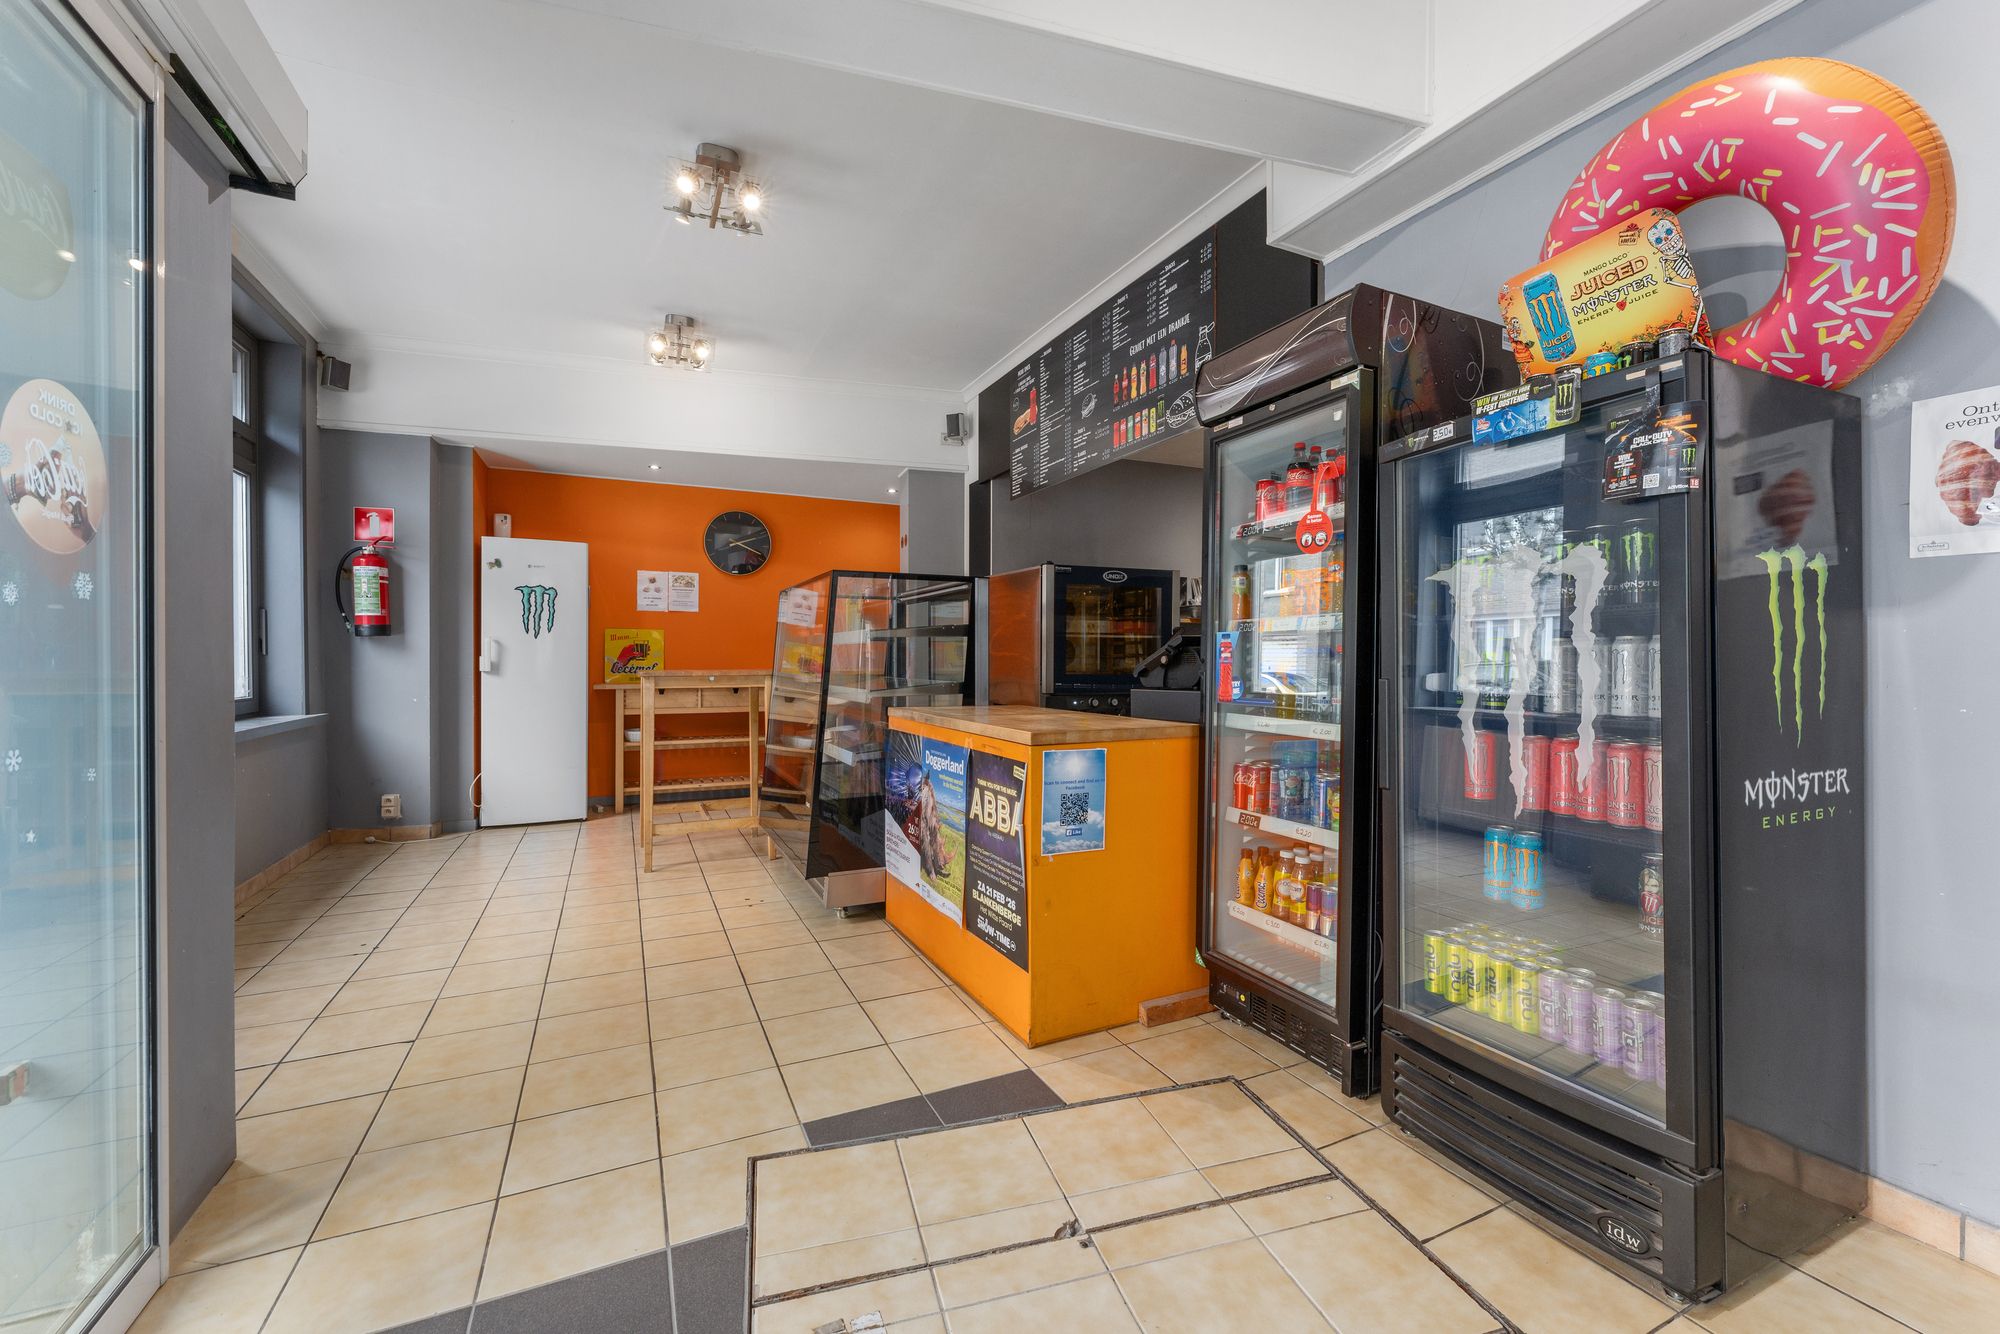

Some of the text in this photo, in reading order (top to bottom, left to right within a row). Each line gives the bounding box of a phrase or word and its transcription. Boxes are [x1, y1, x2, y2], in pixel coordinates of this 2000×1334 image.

[1583, 253, 1628, 276] MANGO LOCO
[1571, 255, 1648, 301] JUICED
[1572, 274, 1658, 317] MONSTER
[1577, 288, 1658, 325] ENERGY JUICE
[1146, 334, 1157, 346] MET
[1476, 397, 1491, 407] WIN
[1633, 435, 1648, 444] CALL
[1652, 430, 1672, 440] DUTY
[925, 750, 964, 775] Doggerland
[1744, 768, 1850, 810] MONSTER
[1762, 806, 1836, 829] ENERGY
[977, 880, 986, 894] ZA
[985, 885, 993, 897] 21
[993, 889, 1005, 905] FEB
[972, 888, 1022, 927] BLANKENBERGE
[998, 915, 1013, 932] Paard
[1517, 978, 1533, 1021] nalu
[1607, 1220, 1640, 1247] idw
